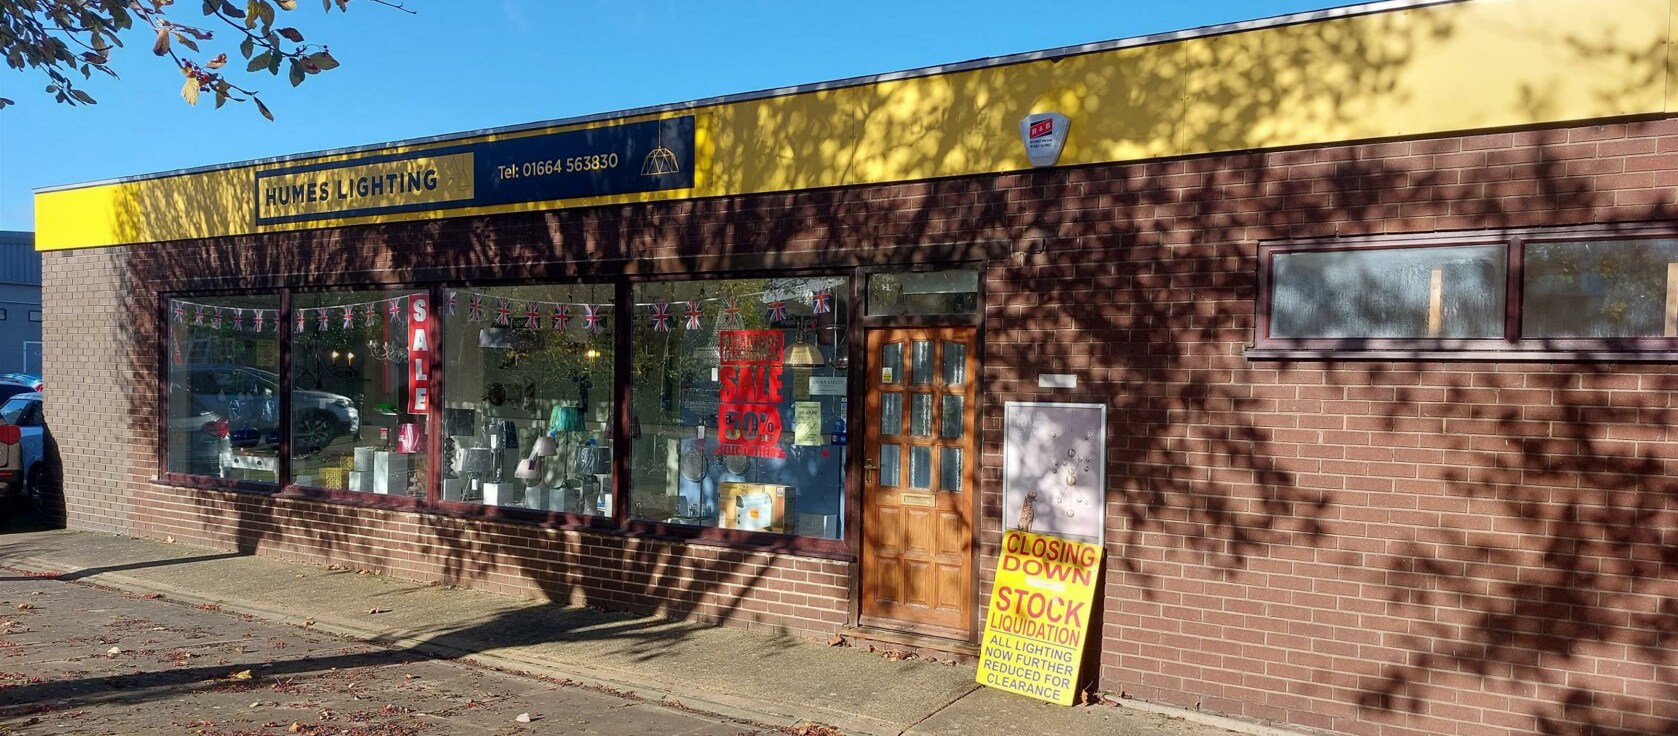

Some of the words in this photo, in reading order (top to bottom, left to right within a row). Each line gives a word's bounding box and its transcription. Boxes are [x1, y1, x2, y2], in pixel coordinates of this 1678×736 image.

[498, 163, 519, 180] Tel:
[522, 159, 562, 177] 01664
[566, 153, 618, 172] 563830
[265, 181, 329, 207] HUMES
[338, 169, 437, 200] LIGHTING
[413, 299, 429, 410] SALE
[720, 366, 783, 403] SALE
[725, 411, 774, 441] 50%
[1007, 533, 1096, 568] CLOSING
[1003, 555, 1091, 586] DOWN
[996, 586, 1085, 628] STOCK
[990, 612, 1080, 648] LIQUIDATION
[985, 646, 1013, 662] NOW
[1016, 653, 1073, 676] FURTHER
[990, 635, 1012, 649] ALL
[1015, 640, 1072, 663] LIGHTING
[984, 659, 1041, 682] REDUCED
[1044, 673, 1070, 690] FOR
[986, 673, 1061, 701] CLEARANCE
